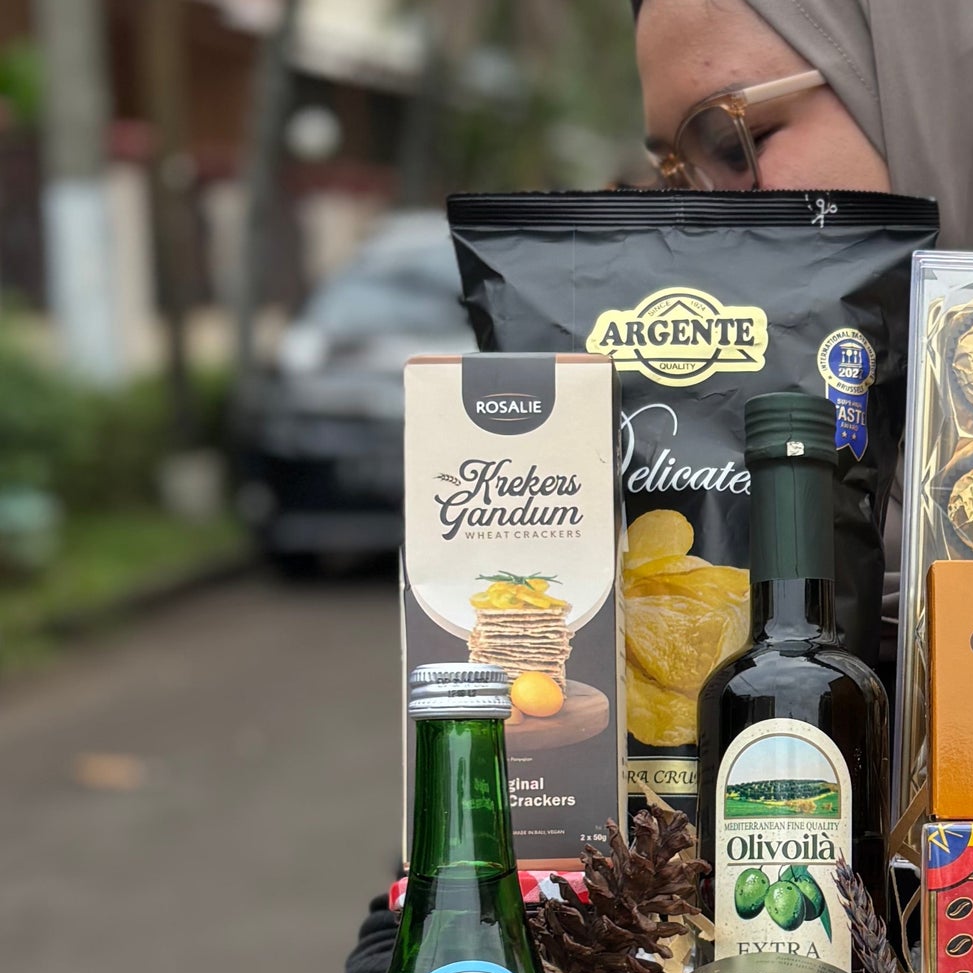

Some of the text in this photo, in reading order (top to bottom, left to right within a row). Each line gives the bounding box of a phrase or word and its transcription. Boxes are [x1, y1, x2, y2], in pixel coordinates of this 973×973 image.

[600, 317, 755, 347] ARGENTE
[659, 362, 696, 371] QUALITY
[476, 400, 542, 414] ROSALIE
[836, 405, 866, 426] ASTE
[459, 459, 581, 505] Krekers
[434, 490, 583, 540] Gandum
[465, 530, 582, 540] WHEAT CRACKERS
[508, 777, 544, 793] ginal
[724, 821, 840, 831] MEDITERRANEAN FINE QUALITY
[727, 832, 836, 861] Olivoilà
